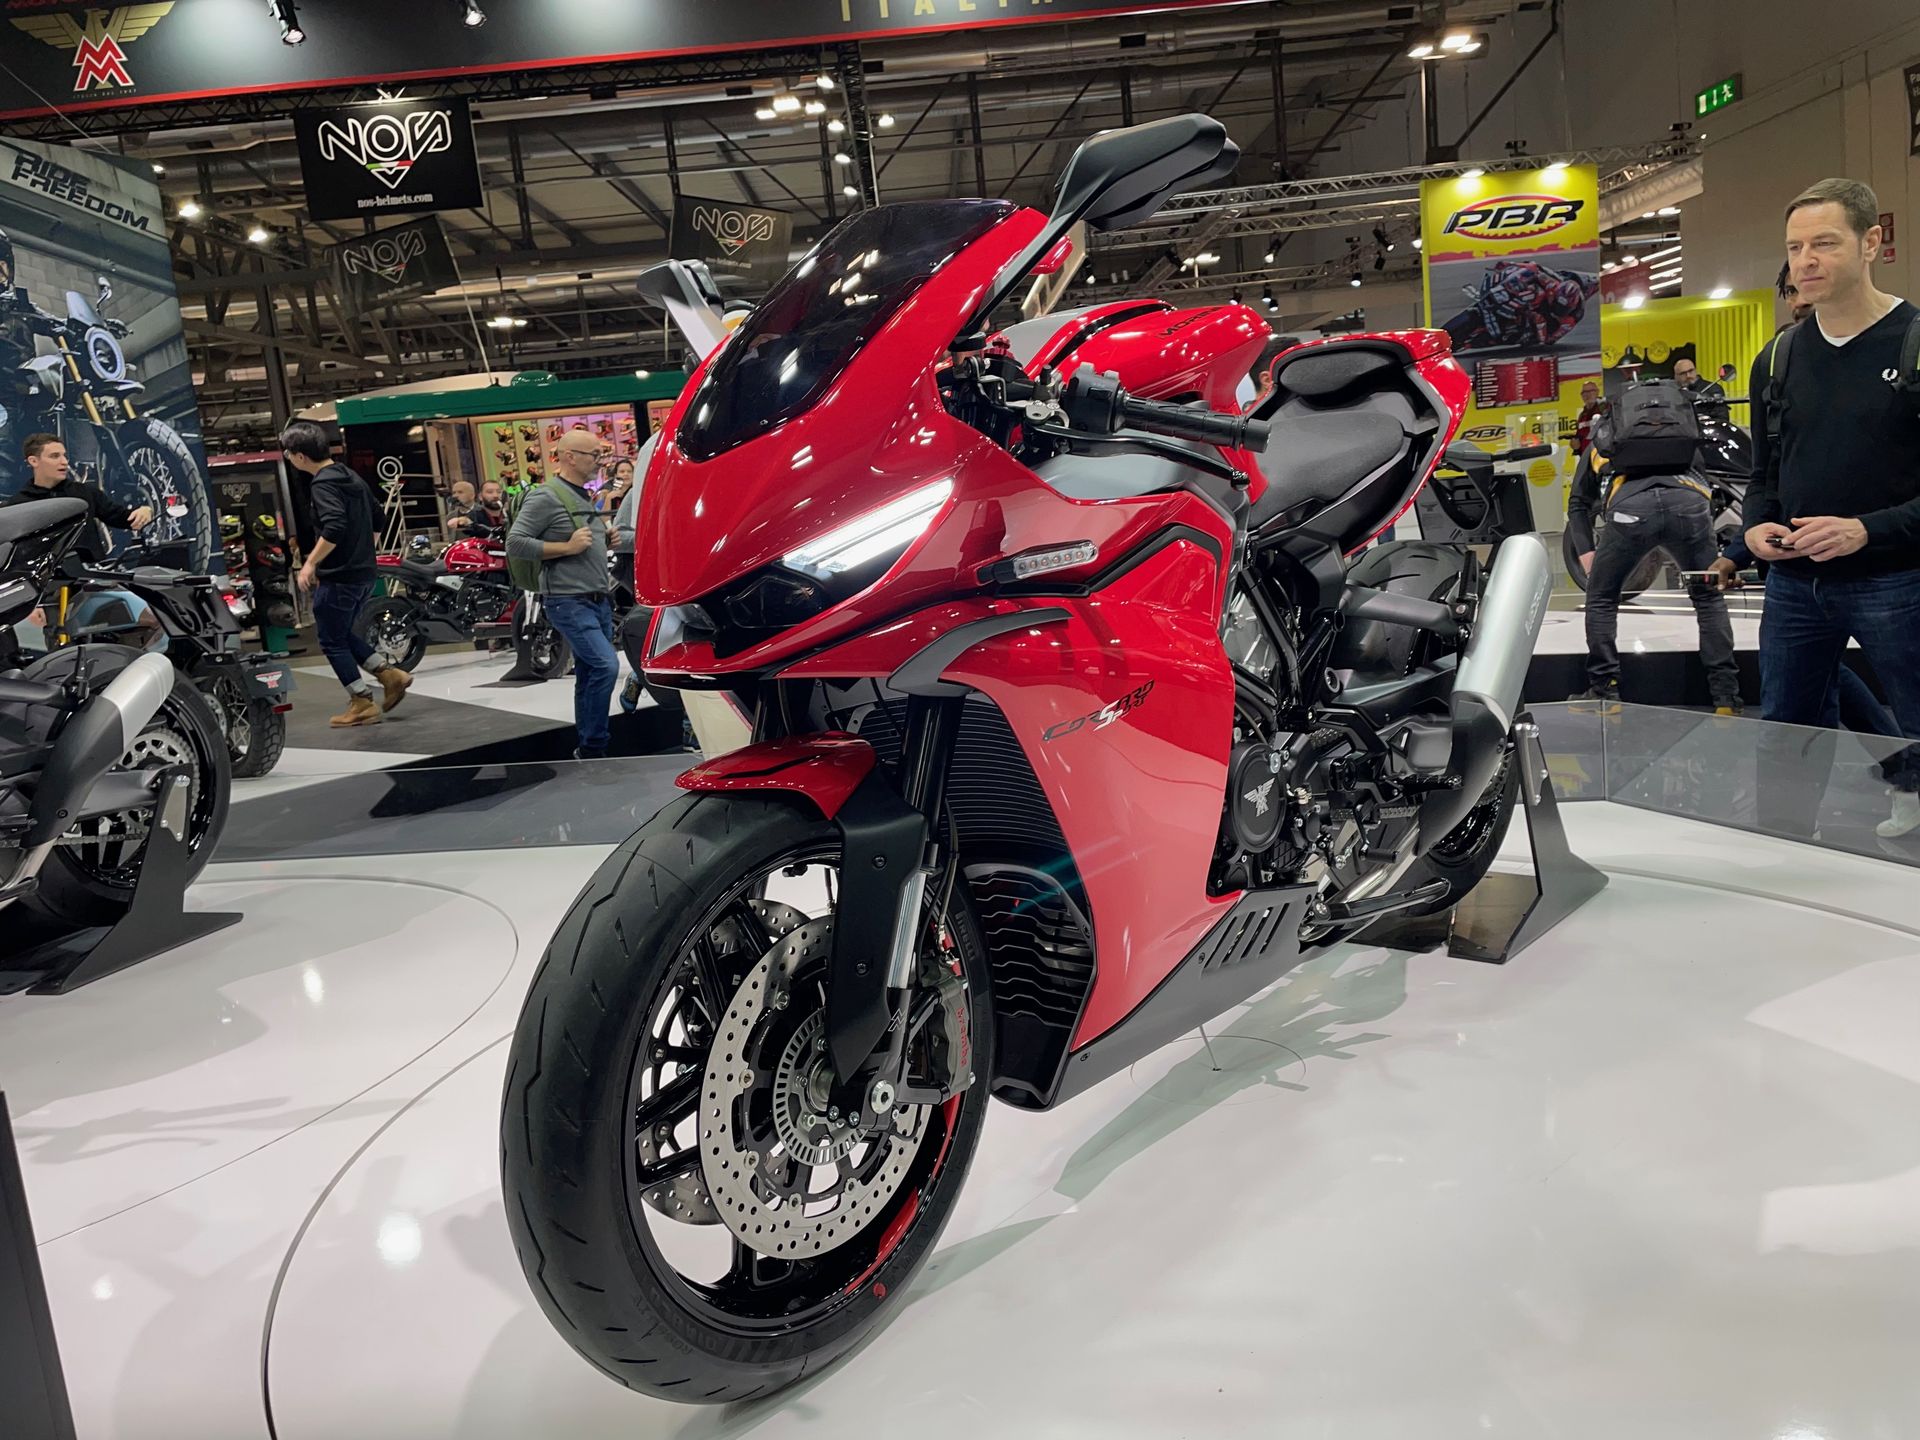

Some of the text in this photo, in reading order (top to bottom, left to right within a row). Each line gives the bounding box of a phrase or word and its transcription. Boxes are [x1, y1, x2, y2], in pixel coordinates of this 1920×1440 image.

[14, 151, 92, 186] RIDE
[11, 165, 150, 231] FREEDOM
[357, 193, 434, 209] nos-helmets.com
[1443, 200, 1584, 234] PBR
